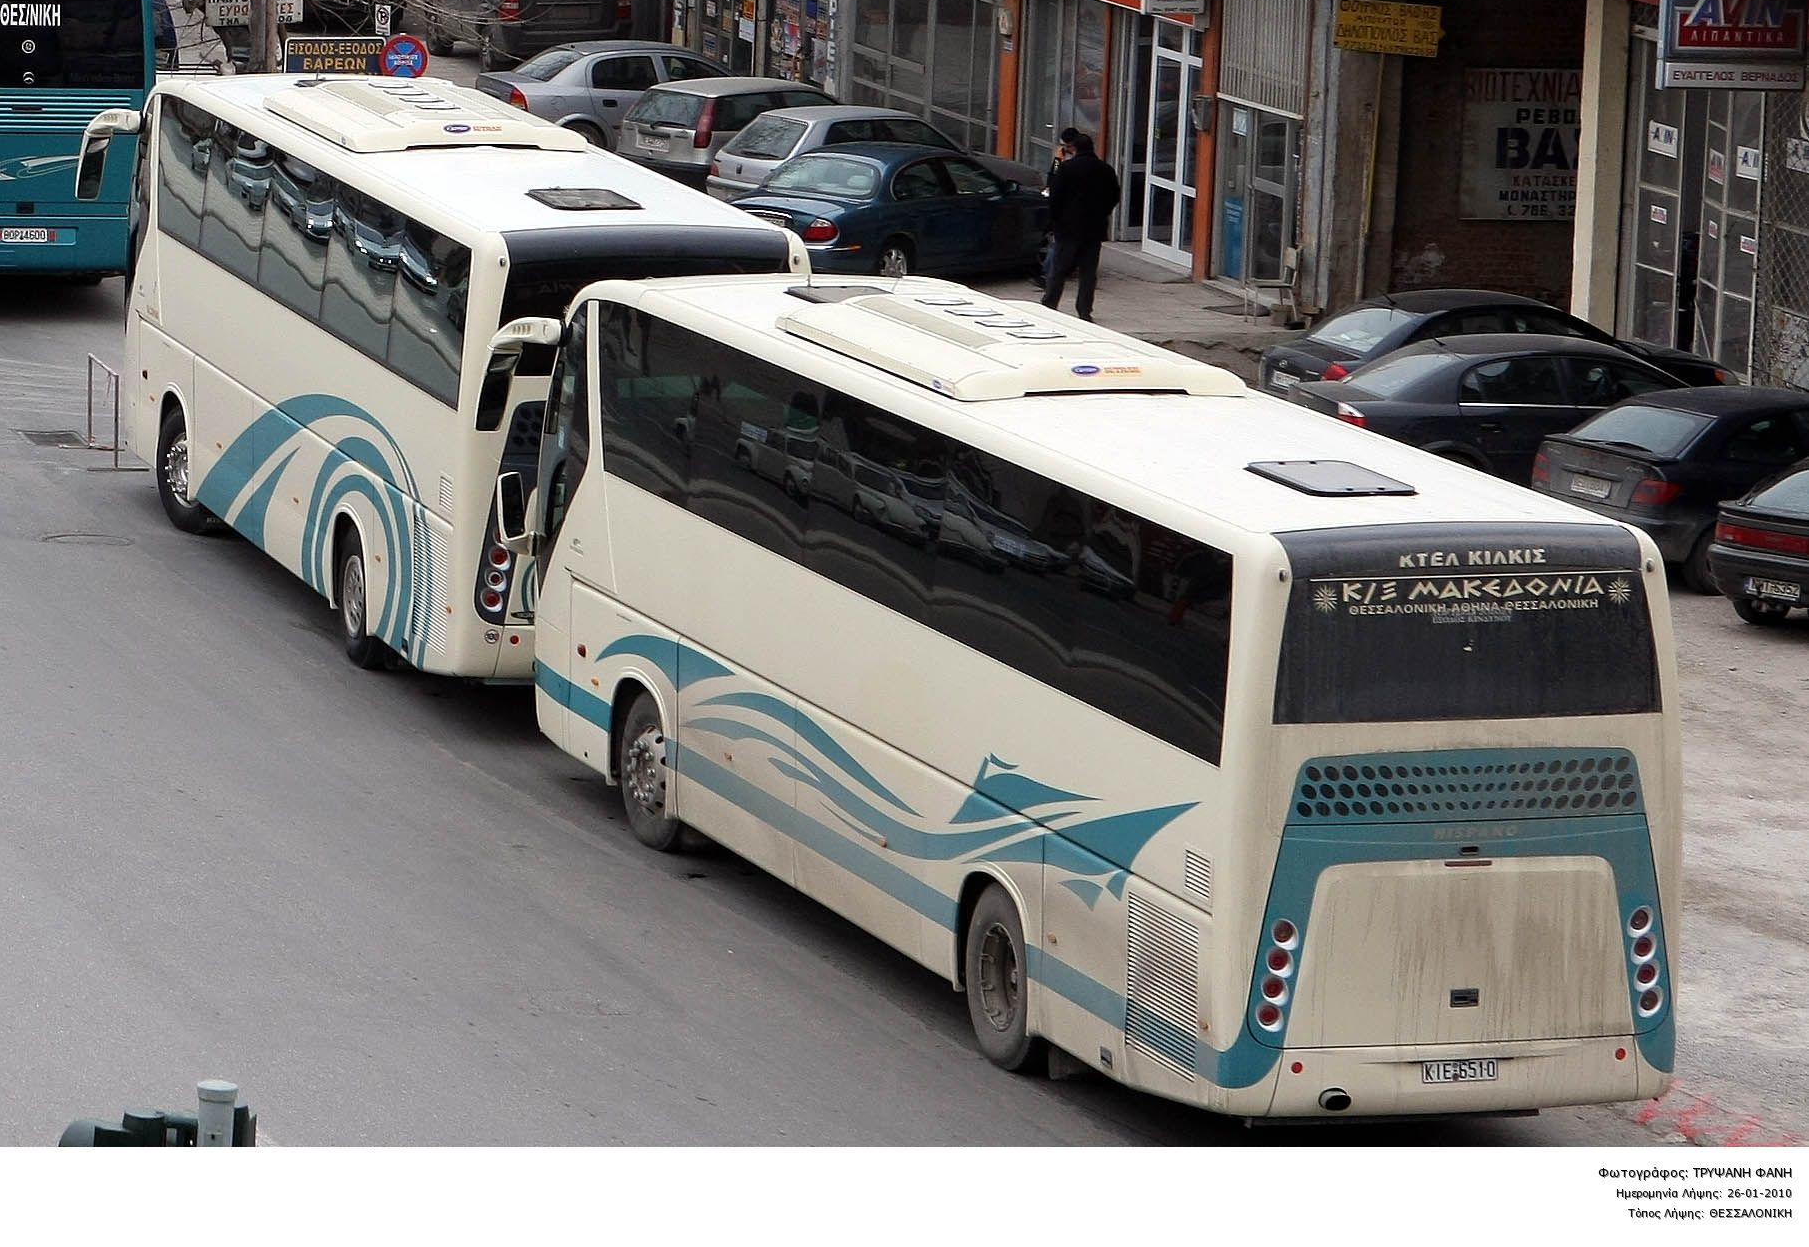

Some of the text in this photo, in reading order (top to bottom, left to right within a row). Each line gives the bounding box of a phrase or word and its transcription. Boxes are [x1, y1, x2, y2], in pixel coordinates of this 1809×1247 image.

[0, 3, 61, 27] ΘΕΣ/ΝΙΚΗ
[1691, 30, 1785, 43] ΛΙΠΑΝΤΙΚΑ
[288, 42, 382, 55] ΕΙΣΟΔΟΣ-ΕΞΟΔΟΣ
[303, 57, 367, 71] ΒΑΡΕΩΝ
[1672, 70, 1800, 83] ΕΥΑΓΓΕΛΟΣ ΒΕΡΝΑΔΟΣ
[1516, 108, 1582, 125] ΡΕΒΟ
[1495, 127, 1581, 170] ΒΑ
[1399, 548, 1547, 569] ΚΤΕΛ ΚΙΛΚΙΣ
[1342, 575, 1606, 604] Κ/Ξ ΜΑΚΕΔΟΝΙΑ
